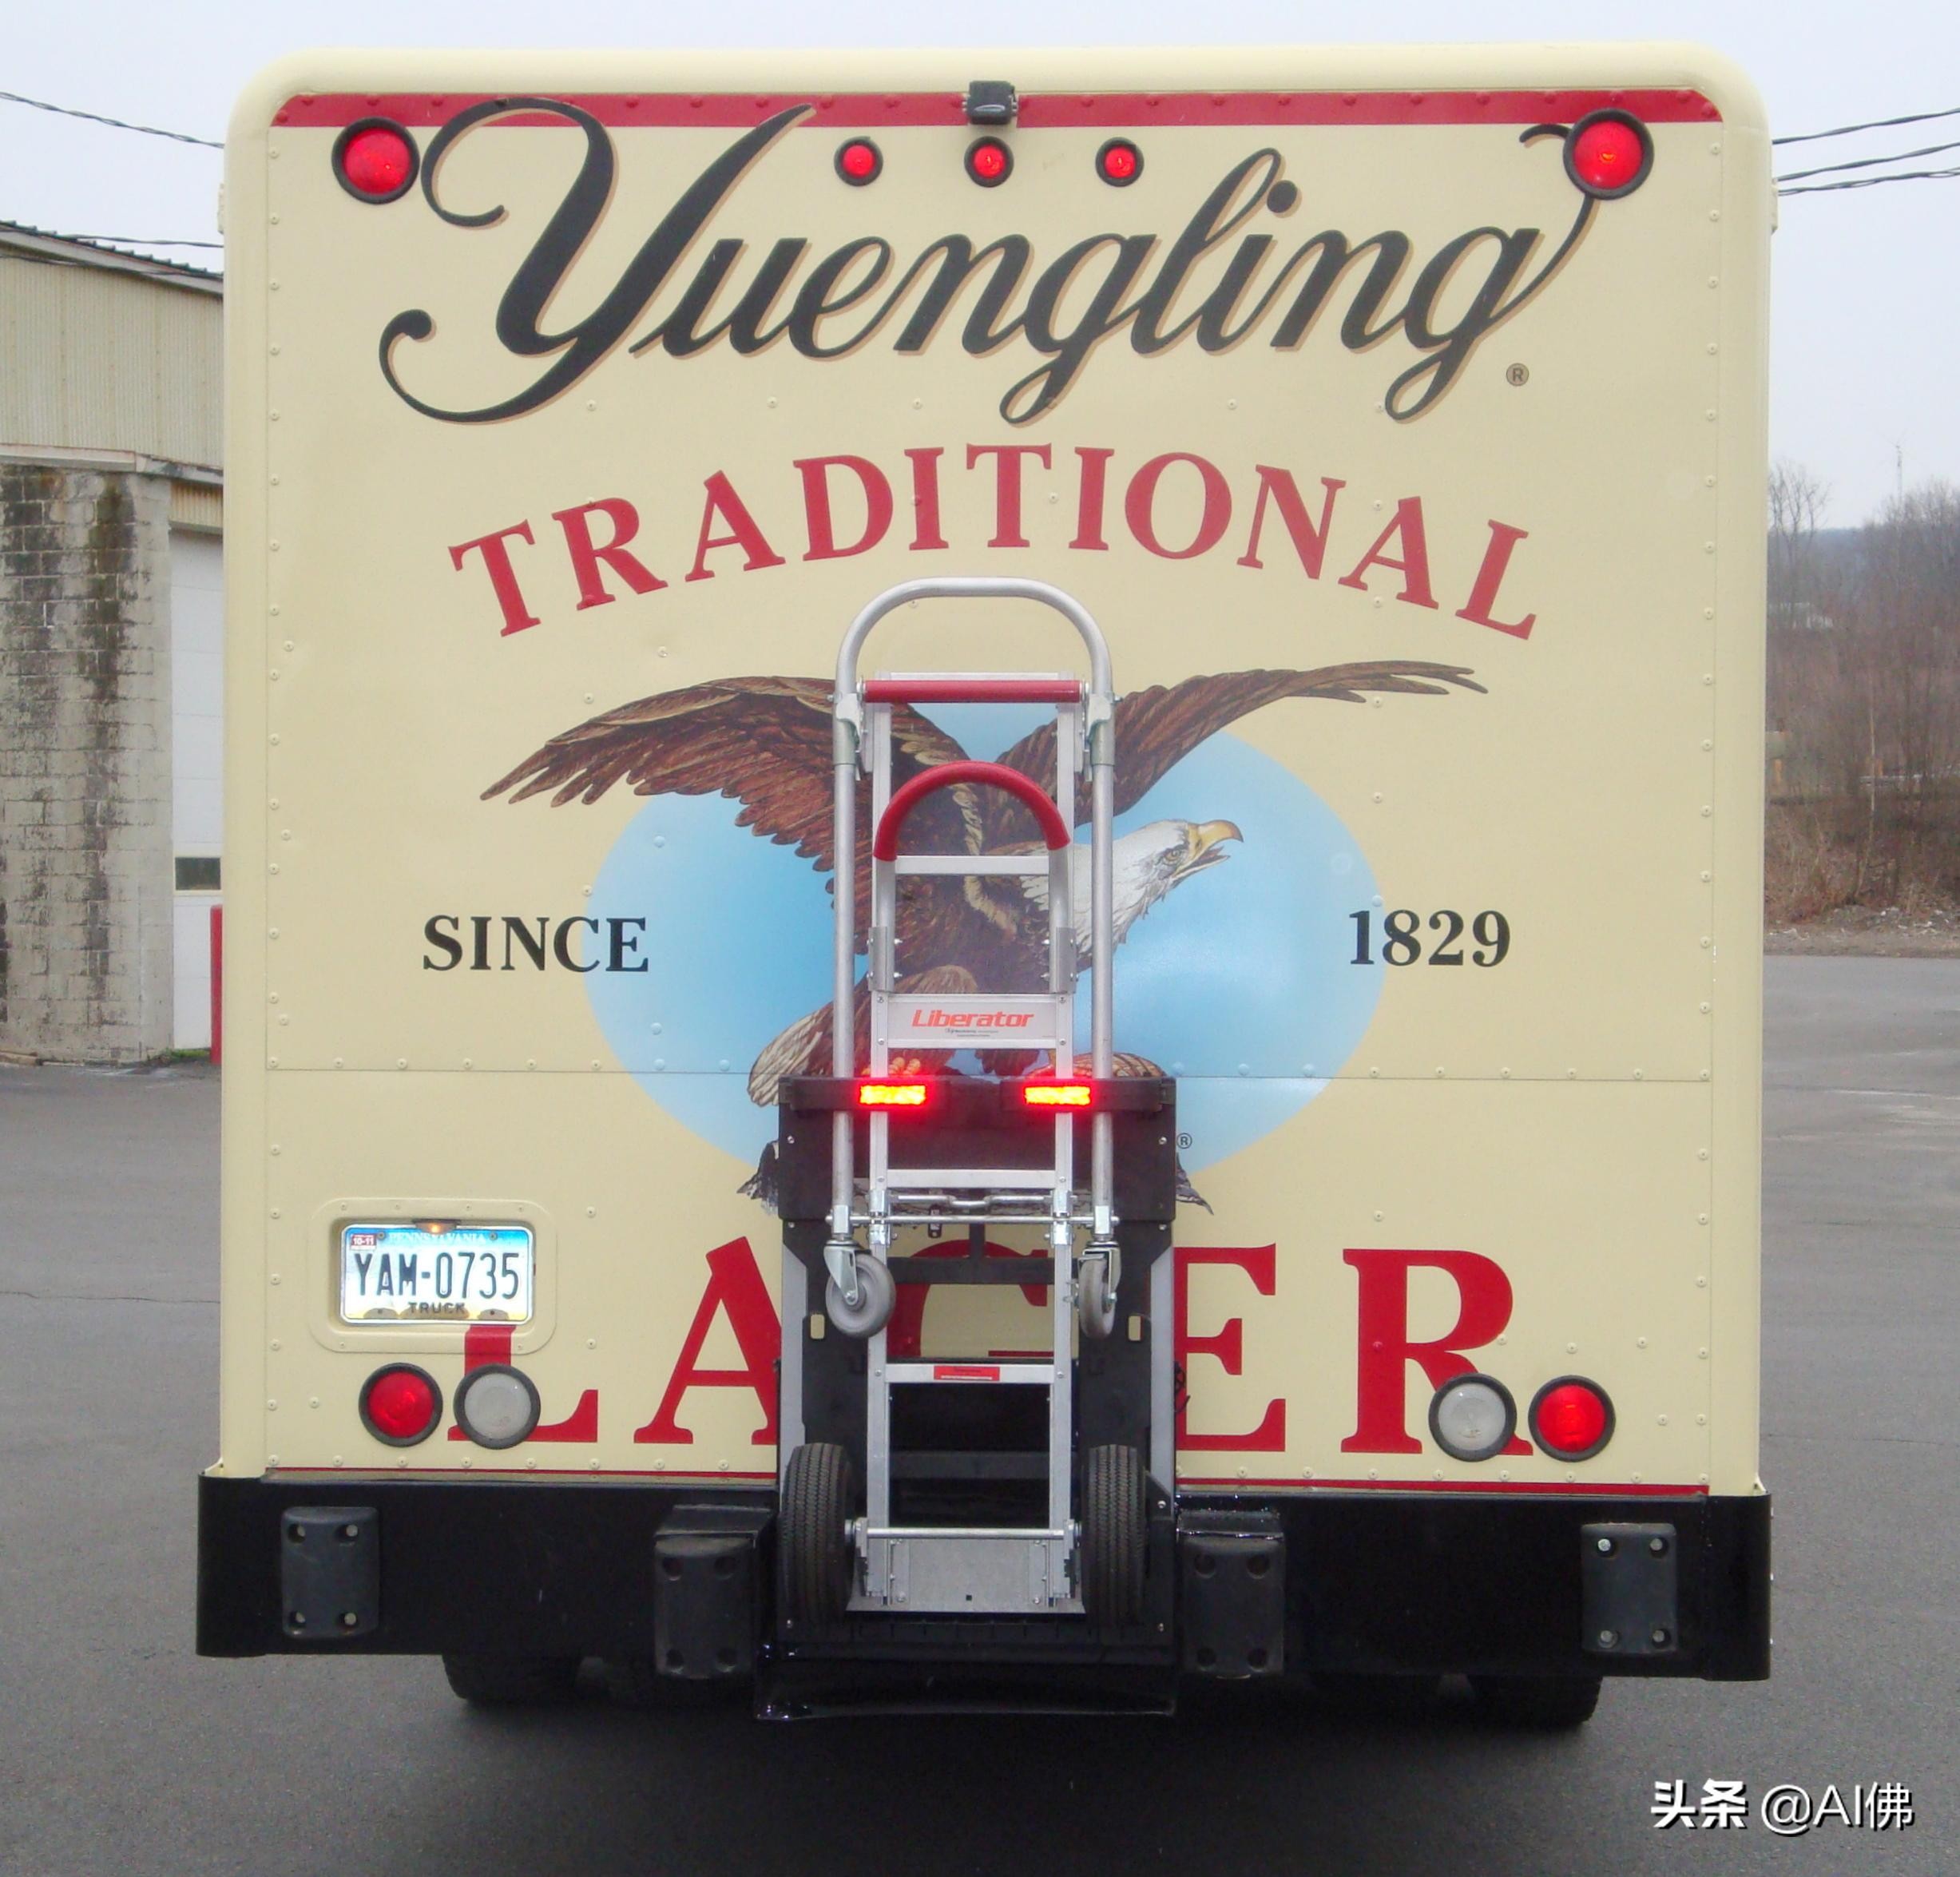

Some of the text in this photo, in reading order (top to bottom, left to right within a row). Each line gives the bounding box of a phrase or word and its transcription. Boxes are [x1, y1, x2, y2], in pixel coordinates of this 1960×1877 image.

[379, 97, 1597, 426] Yuengling
[448, 443, 1537, 641] TRADITIONAL
[423, 909, 1510, 973] SINCE 1829
[911, 1009, 1034, 1028] Liberator
[354, 1252, 519, 1300] YAM-0735
[408, 1301, 466, 1315] TRUCK
